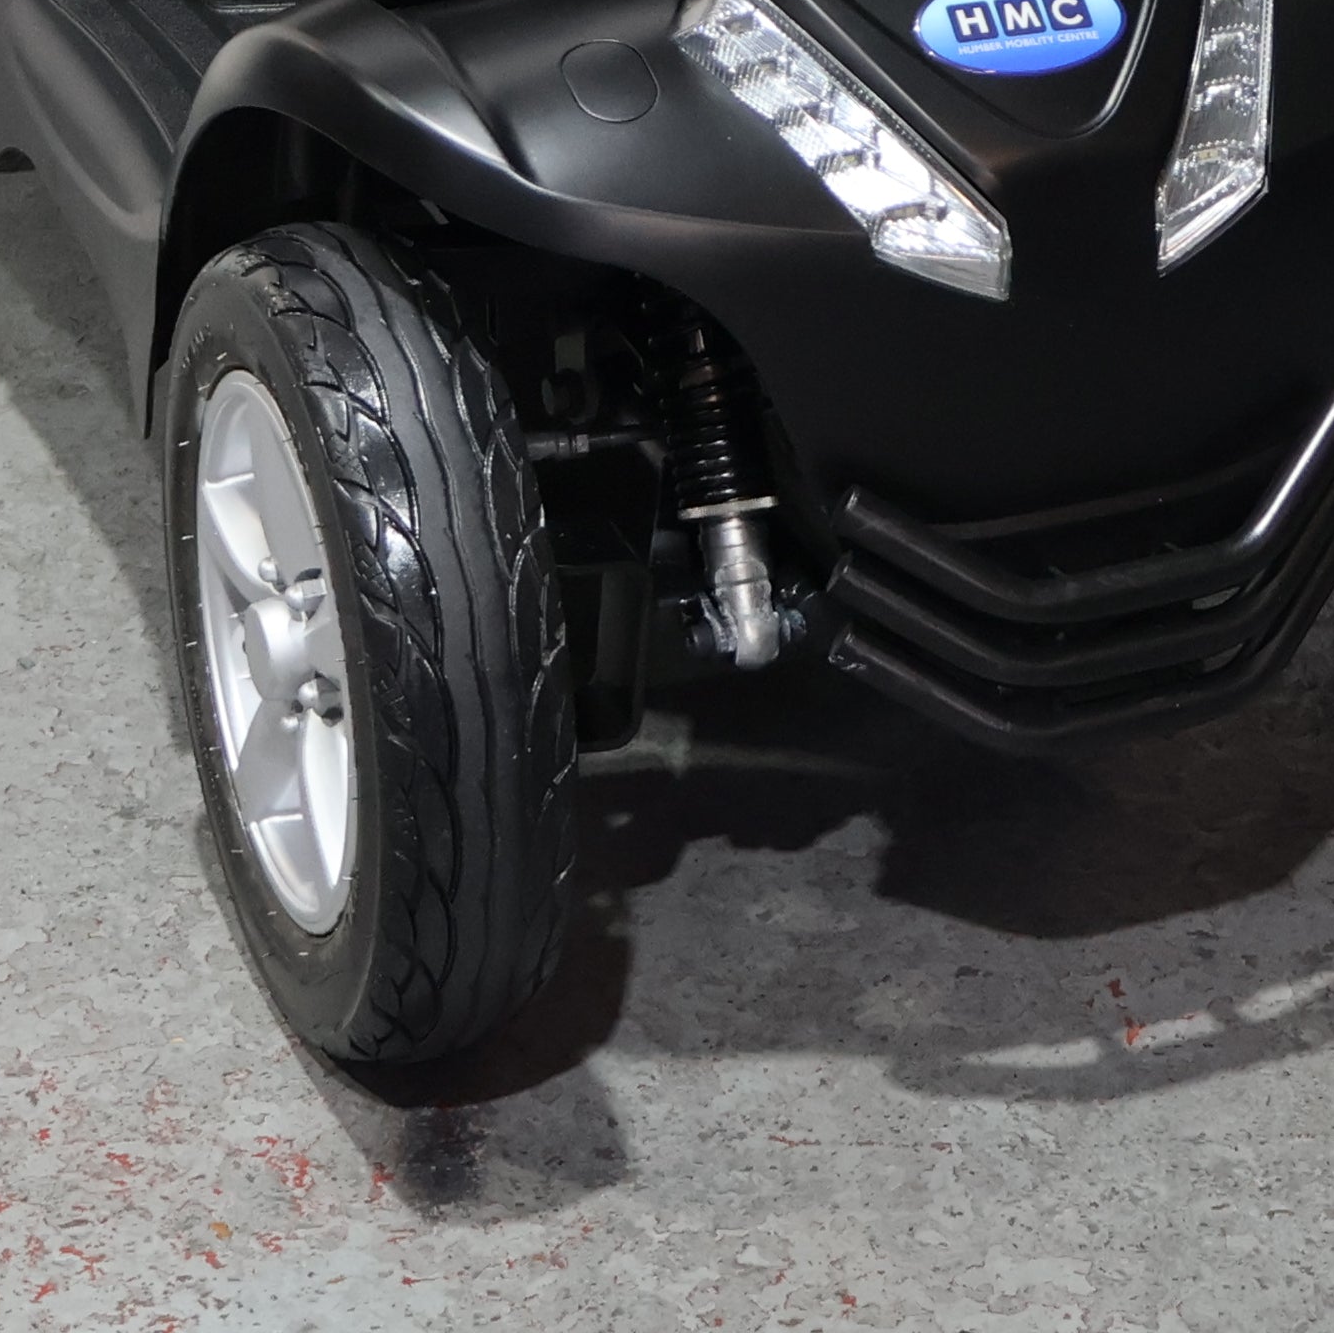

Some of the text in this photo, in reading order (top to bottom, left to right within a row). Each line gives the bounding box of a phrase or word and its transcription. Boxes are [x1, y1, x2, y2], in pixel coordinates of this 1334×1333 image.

[958, 30, 1100, 56] HUMBER MOBILITY CENTRE
